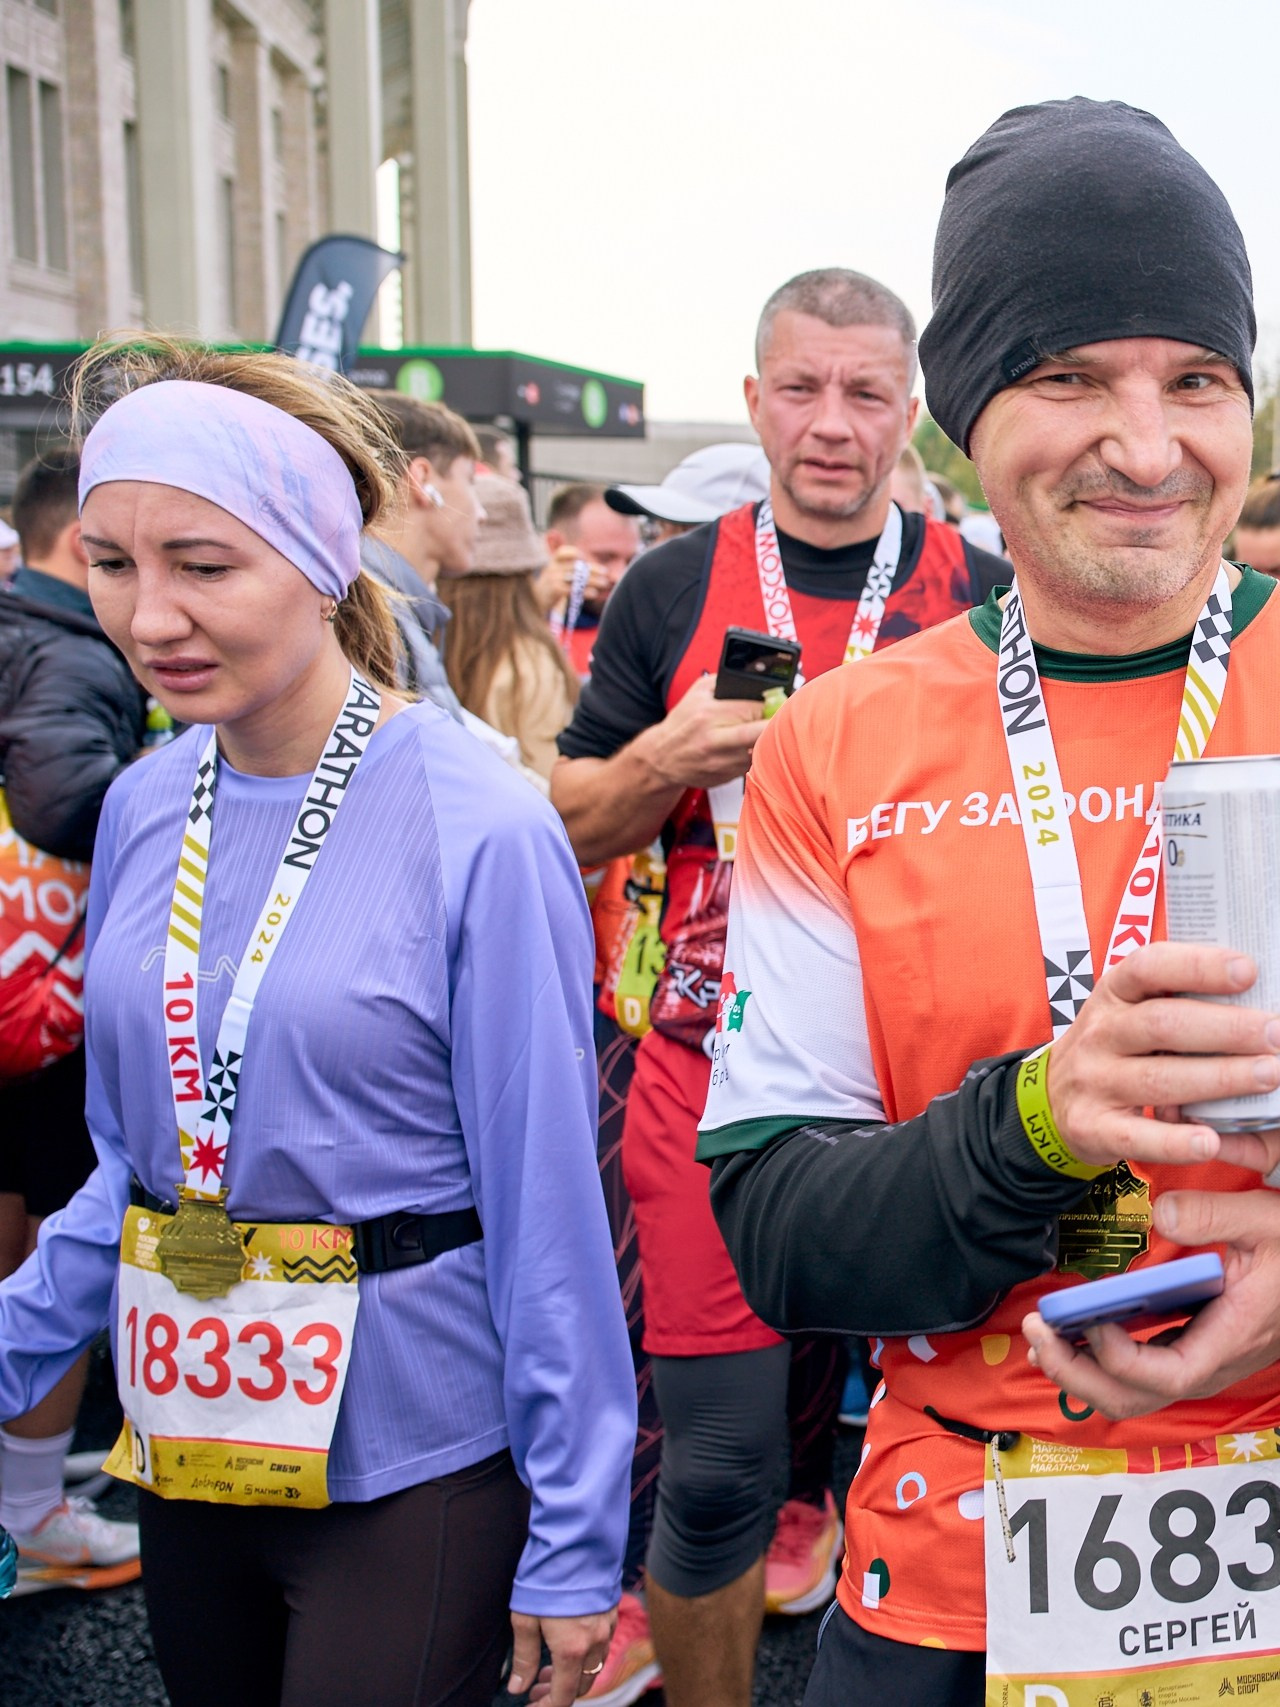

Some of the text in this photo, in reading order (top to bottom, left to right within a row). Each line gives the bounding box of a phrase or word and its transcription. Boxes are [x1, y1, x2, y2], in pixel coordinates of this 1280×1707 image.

[1022, 761, 1060, 847] 2024
[847, 800, 951, 853] БЕГУ
[251, 892, 292, 965] 2024
[165, 971, 203, 1103] 10 KM
[1026, 1113, 1051, 1148] KM
[1047, 1152, 1070, 1169] 10
[277, 1227, 352, 1250] 10 KM
[126, 1306, 343, 1405] 18333
[270, 1463, 302, 1474] СИБУР
[1029, 1463, 1090, 1473] MARATHON
[1031, 1453, 1079, 1463] MOSCOW
[1118, 1601, 1258, 1656] СЕРГЕЙ
[1237, 1683, 1260, 1696] СПОРТ
